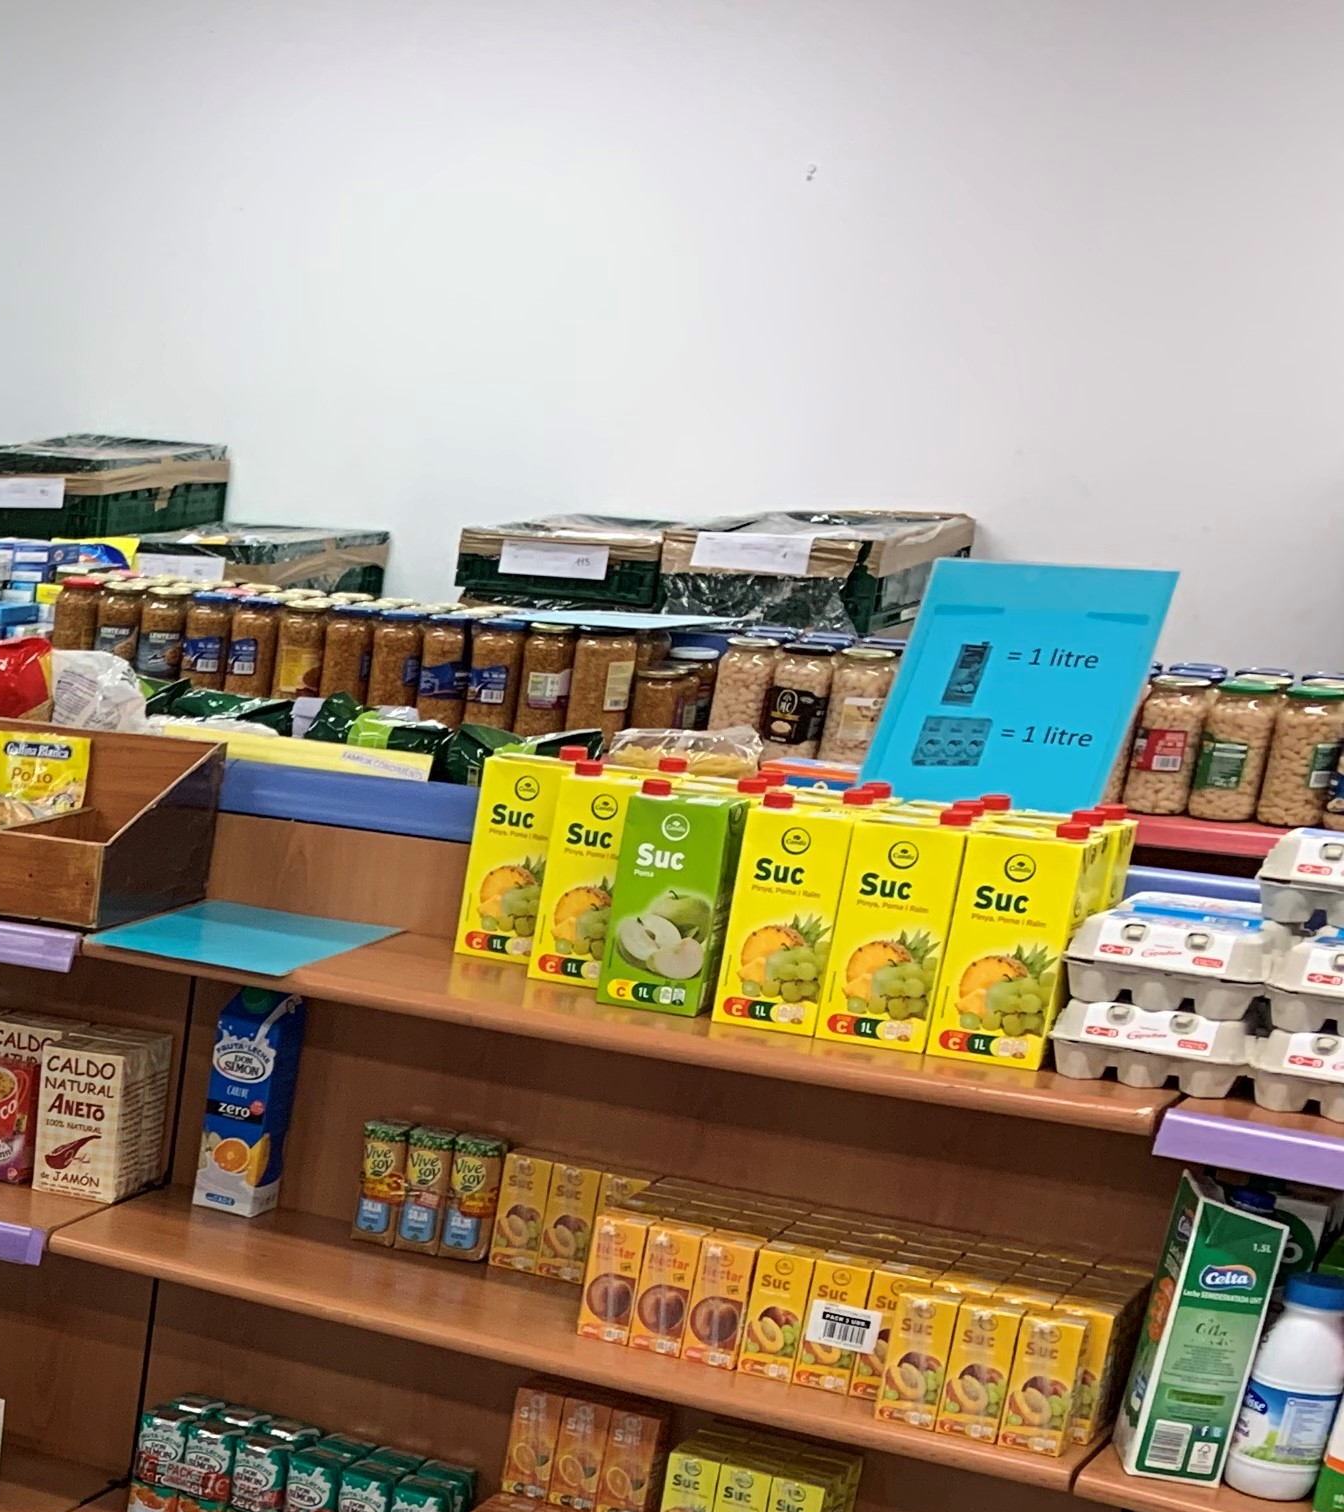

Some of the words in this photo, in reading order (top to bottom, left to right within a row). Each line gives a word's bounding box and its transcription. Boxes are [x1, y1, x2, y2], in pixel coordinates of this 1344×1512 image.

[1028, 648, 1042, 665] 1
[1049, 648, 1099, 670] litre
[1023, 726, 1035, 743] 1
[1045, 726, 1093, 747] litre
[491, 804, 535, 829] Suc
[566, 823, 613, 849] Suc
[636, 843, 684, 870] Suc
[634, 869, 654, 878] Poma
[754, 858, 804, 885] Suc
[860, 872, 912, 900] Suc
[973, 886, 1029, 914] Suc
[567, 963, 577, 974] 1L
[638, 987, 649, 998] 1L
[861, 1022, 872, 1034] 1L
[974, 1038, 986, 1050] 1L
[47, 1056, 116, 1080] CALDO
[44, 1078, 115, 1098] NATURAL
[218, 1102, 251, 1118] zero
[365, 1148, 391, 1161] Vive
[410, 1154, 439, 1167] Vive
[418, 1165, 441, 1181] soy
[455, 1160, 483, 1174] Vive
[53, 1172, 100, 1188] JAMÓN
[462, 1172, 485, 1187] soy
[762, 1274, 791, 1292] Suc
[1205, 1271, 1249, 1285] Celta
[825, 1314, 842, 1322] PACK
